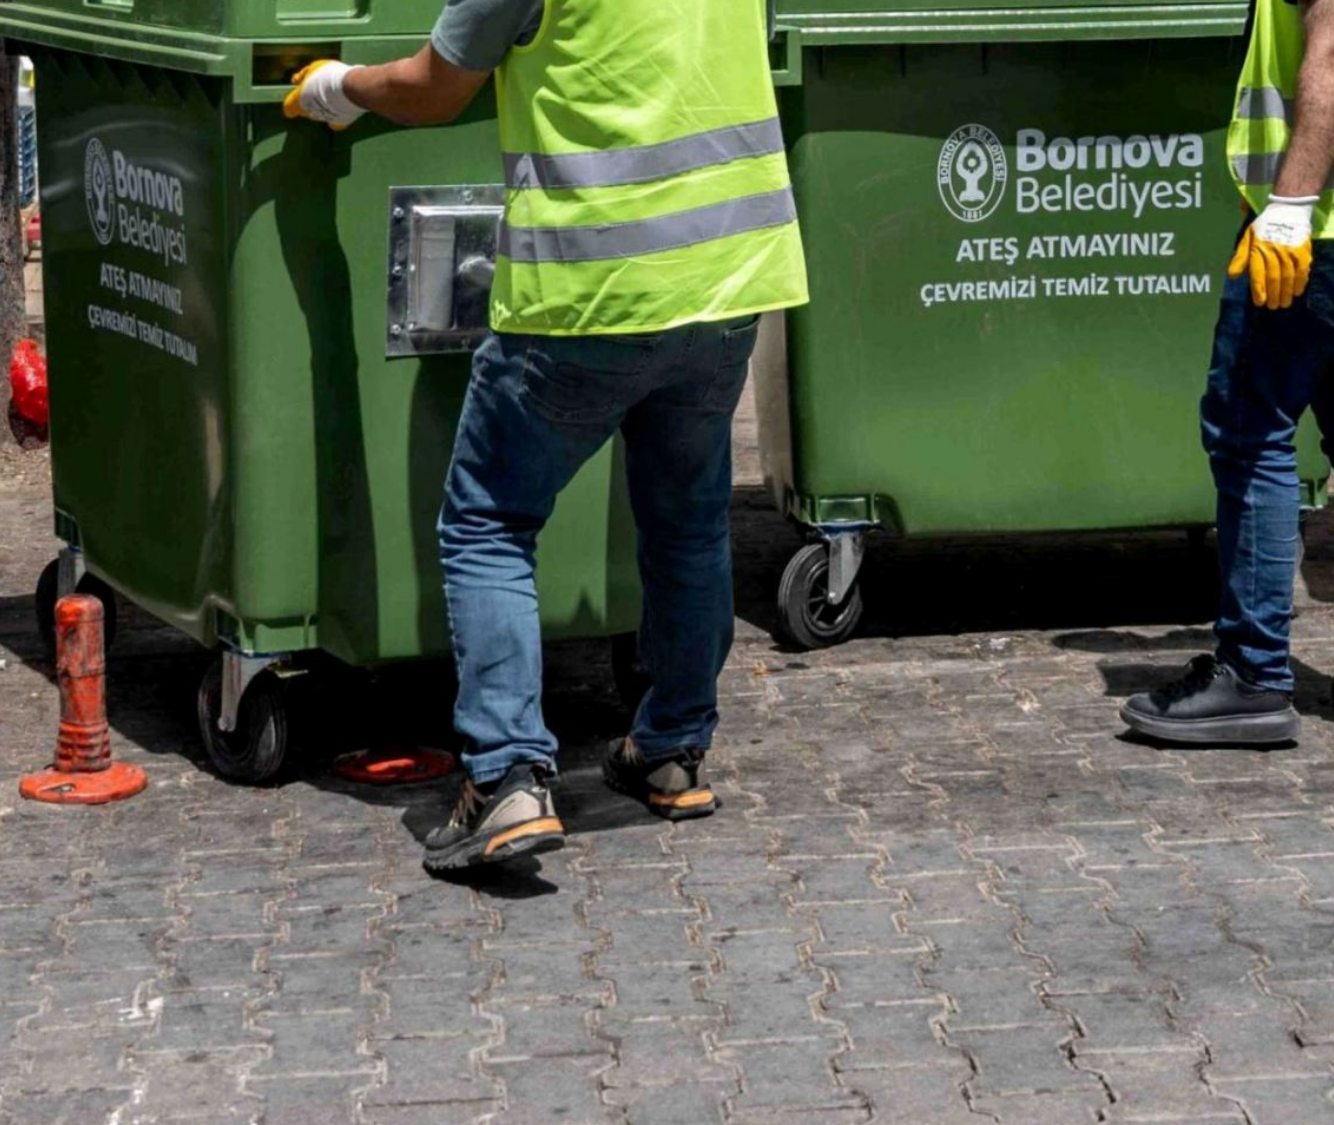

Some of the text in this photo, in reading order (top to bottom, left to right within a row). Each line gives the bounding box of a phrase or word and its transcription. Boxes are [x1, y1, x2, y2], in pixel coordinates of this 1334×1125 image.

[1016, 127, 1205, 172] Bornova
[113, 150, 185, 217] Bornova
[1017, 172, 1203, 218] Belediyesi
[118, 202, 187, 267] Belediyesi
[955, 232, 1176, 265] ATEŞ ATMAYINIZ
[100, 262, 183, 315] ATEŞ ATMAYINIZ
[920, 272, 1211, 307] ÇEVREMİZİ TEMİZ TUTALIM
[137, 318, 164, 349] TEMİZ
